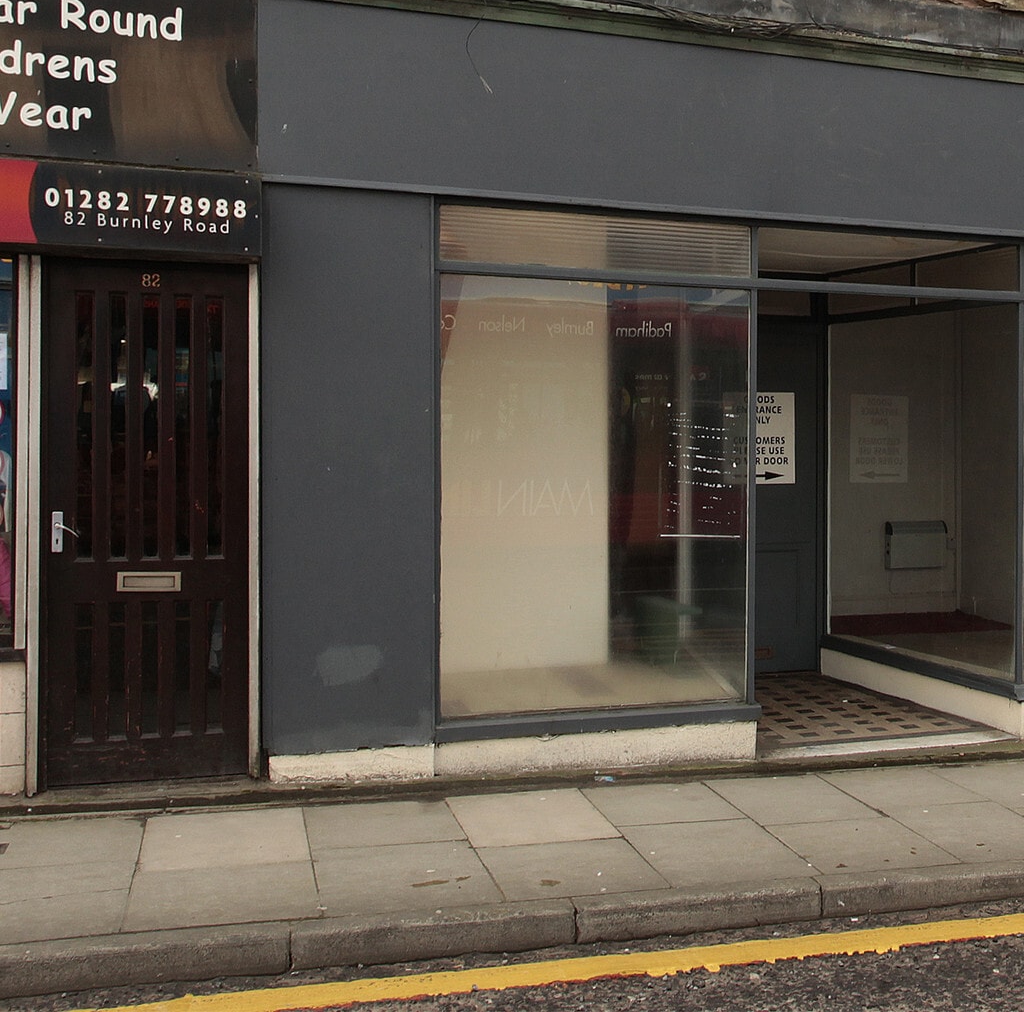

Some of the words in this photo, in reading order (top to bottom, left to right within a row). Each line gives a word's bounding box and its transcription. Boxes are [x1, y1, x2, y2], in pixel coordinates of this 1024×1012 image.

[44, 187, 130, 212] 01282
[144, 193, 247, 219] 778988
[63, 211, 86, 226] 82
[97, 213, 173, 235] Burnley
[183, 218, 230, 234] Road
[141, 273, 161, 288] 82
[768, 446, 785, 455] USE
[763, 456, 789, 465] DOOR
